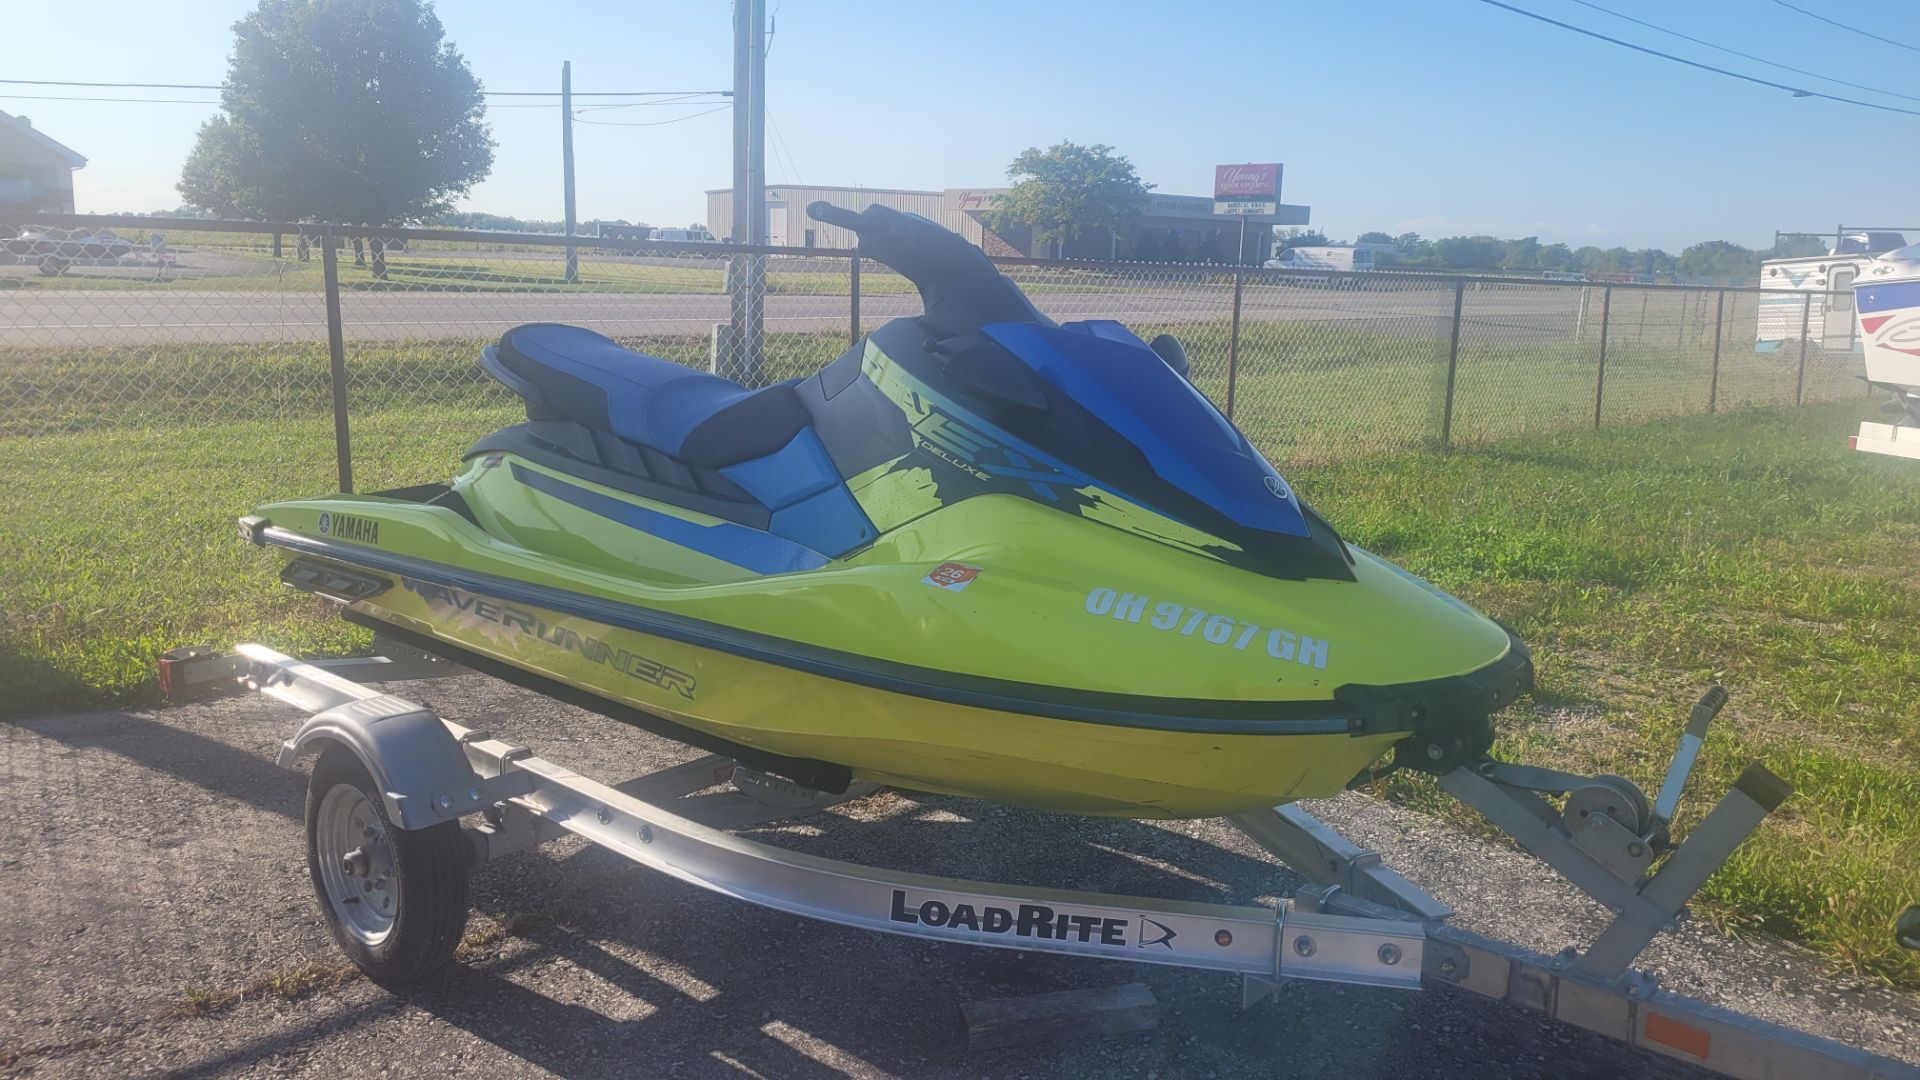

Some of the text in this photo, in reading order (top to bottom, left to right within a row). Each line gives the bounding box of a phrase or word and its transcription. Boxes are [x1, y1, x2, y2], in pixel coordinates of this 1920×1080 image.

[1222, 167, 1268, 189] Young's
[921, 441, 992, 482] DELUXE
[332, 513, 379, 544] YAMAHA
[401, 576, 697, 701] WAVERUNNER
[1085, 586, 1331, 671] OH 9767 GH
